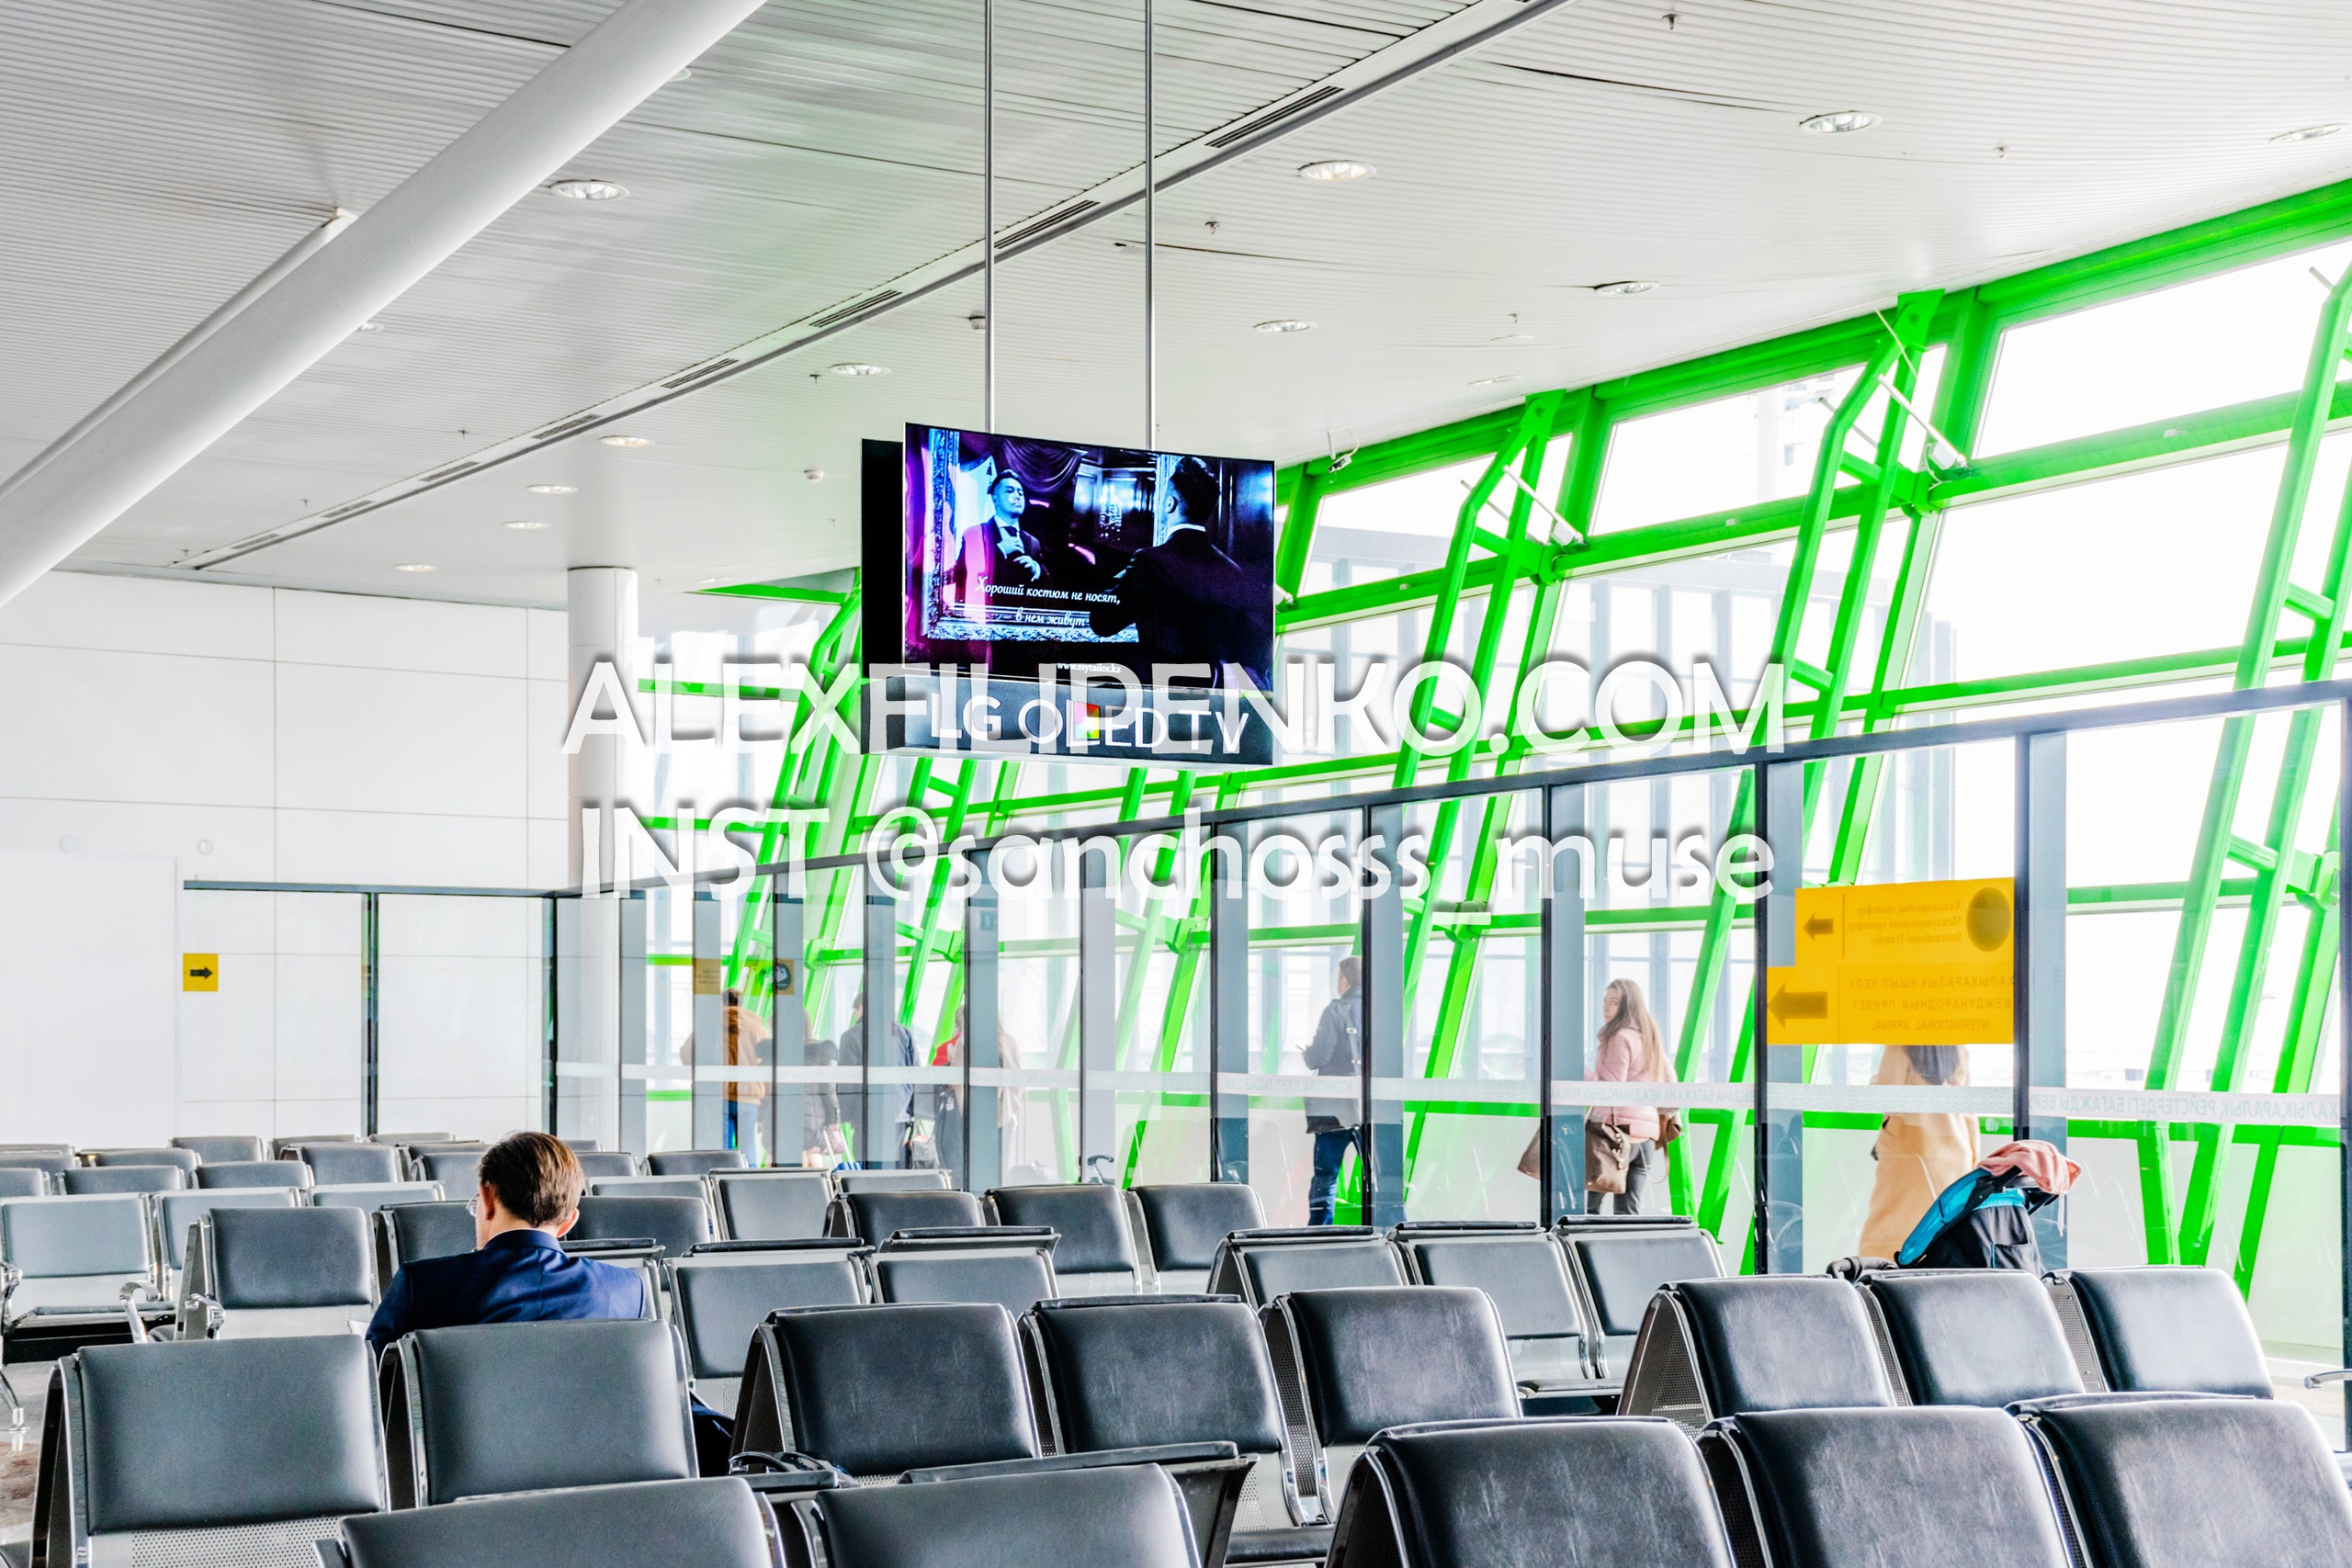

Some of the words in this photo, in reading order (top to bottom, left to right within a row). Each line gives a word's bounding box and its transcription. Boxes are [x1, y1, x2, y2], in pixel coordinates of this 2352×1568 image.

[975, 575, 1024, 597] Хороший
[1026, 588, 1069, 599] костюм
[1071, 591, 1083, 601] не
[1085, 592, 1121, 604] носят,
[1015, 606, 1023, 622] в
[1024, 614, 1045, 624] нем
[1046, 611, 1085, 628] живут
[1057, 662, 1122, 674] www.mytailor.kz
[932, 693, 1003, 740] LG
[1018, 698, 1168, 748] OLED
[1178, 708, 1249, 751] TV
